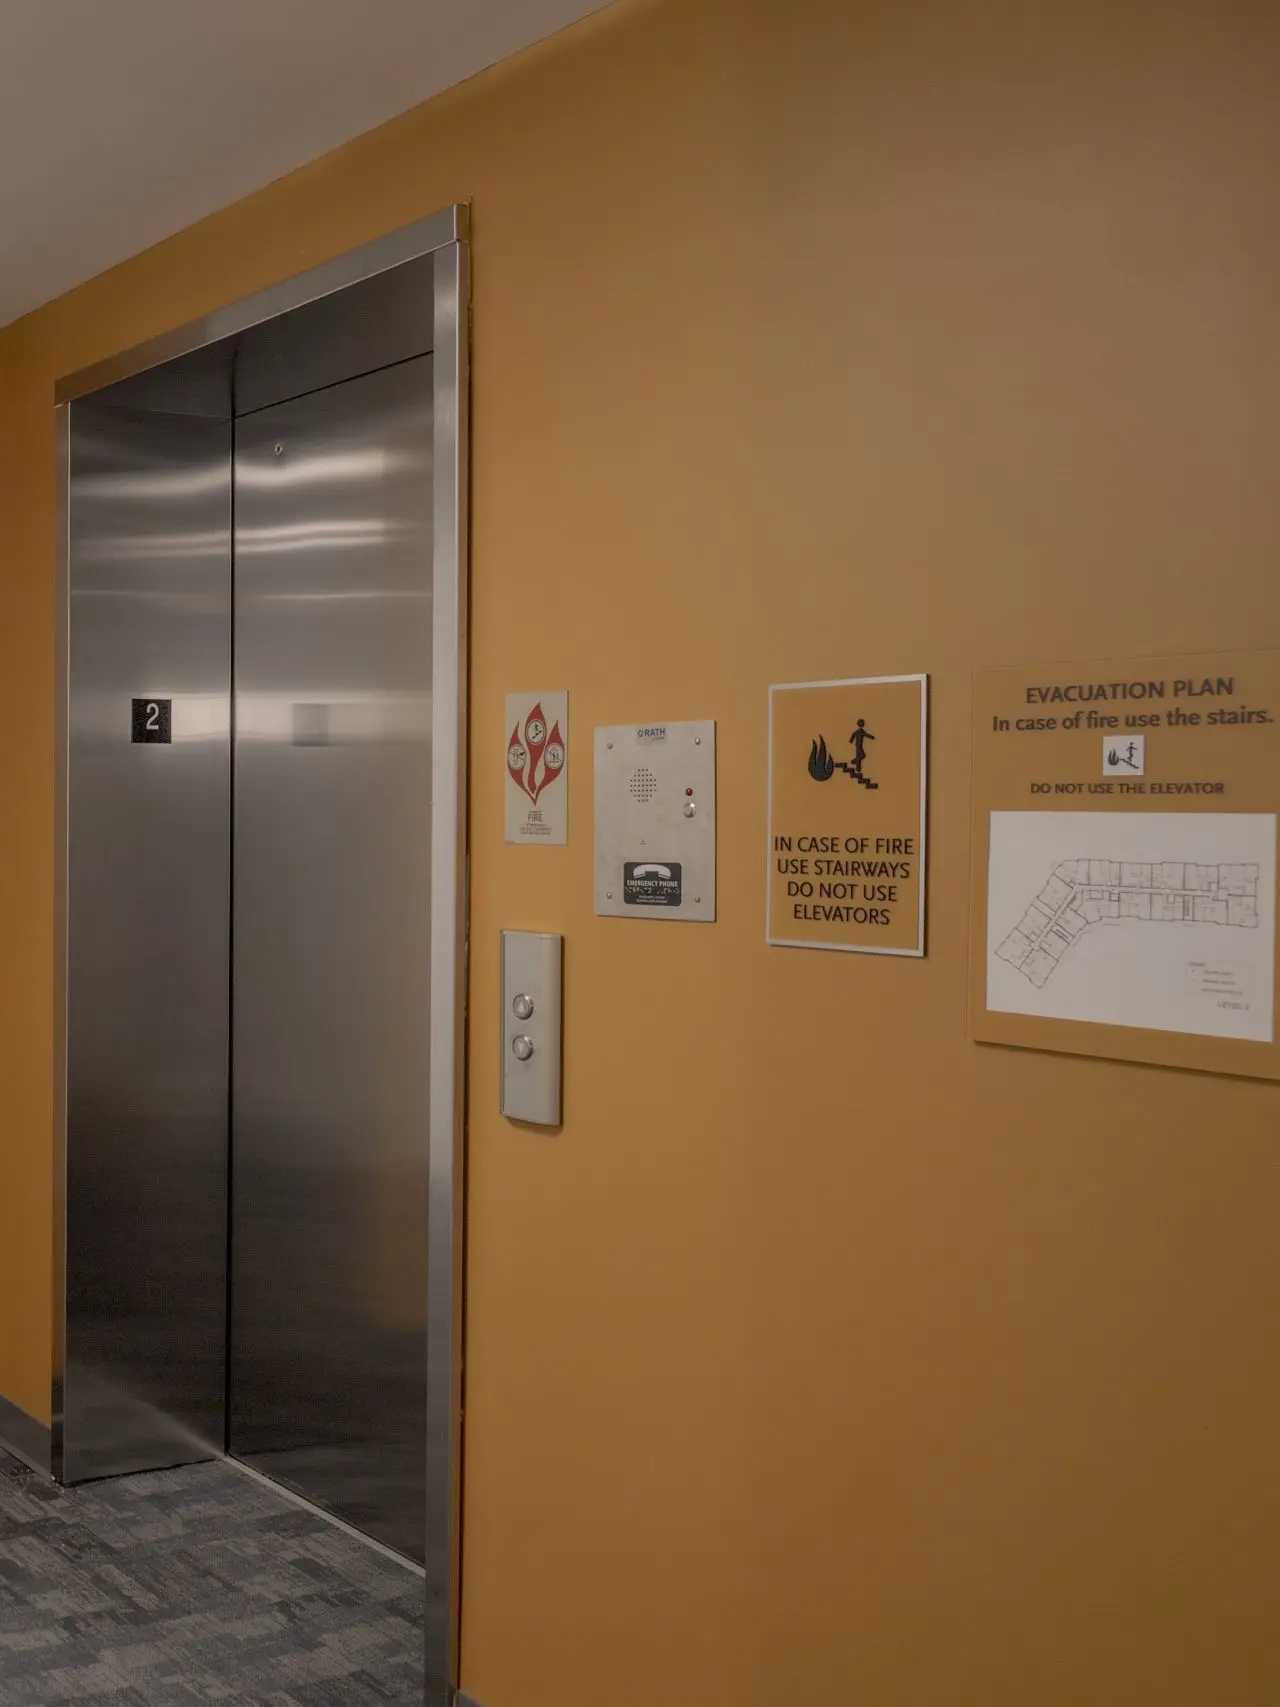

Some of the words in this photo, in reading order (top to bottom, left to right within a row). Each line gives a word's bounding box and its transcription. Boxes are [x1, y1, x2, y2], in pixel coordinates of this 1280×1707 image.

[1026, 681, 1165, 704] EVACUATION
[1173, 676, 1235, 698] PLAN
[146, 702, 159, 730] 2
[993, 715, 1010, 732] In
[1015, 717, 1057, 731] case
[1062, 711, 1084, 730] of
[1086, 710, 1119, 729] fire
[1125, 714, 1161, 728] use
[1166, 707, 1200, 726] the
[1206, 705, 1274, 725] stairs.
[1030, 783, 1052, 794] DO
[1055, 783, 1084, 794] NOT
[1088, 783, 1114, 794] USE
[1118, 783, 1146, 794] THE
[1150, 782, 1225, 795] ELEVATOR
[774, 836, 792, 852] IN
[797, 837, 840, 853] CASE
[844, 837, 869, 854] OF
[876, 838, 915, 855] FIRE
[777, 858, 809, 875] USE
[814, 859, 910, 879] STAIRWAYS
[787, 881, 813, 898] DO
[819, 882, 858, 900] NOT
[863, 885, 898, 902] USE
[793, 903, 891, 926] ELEVATORS
